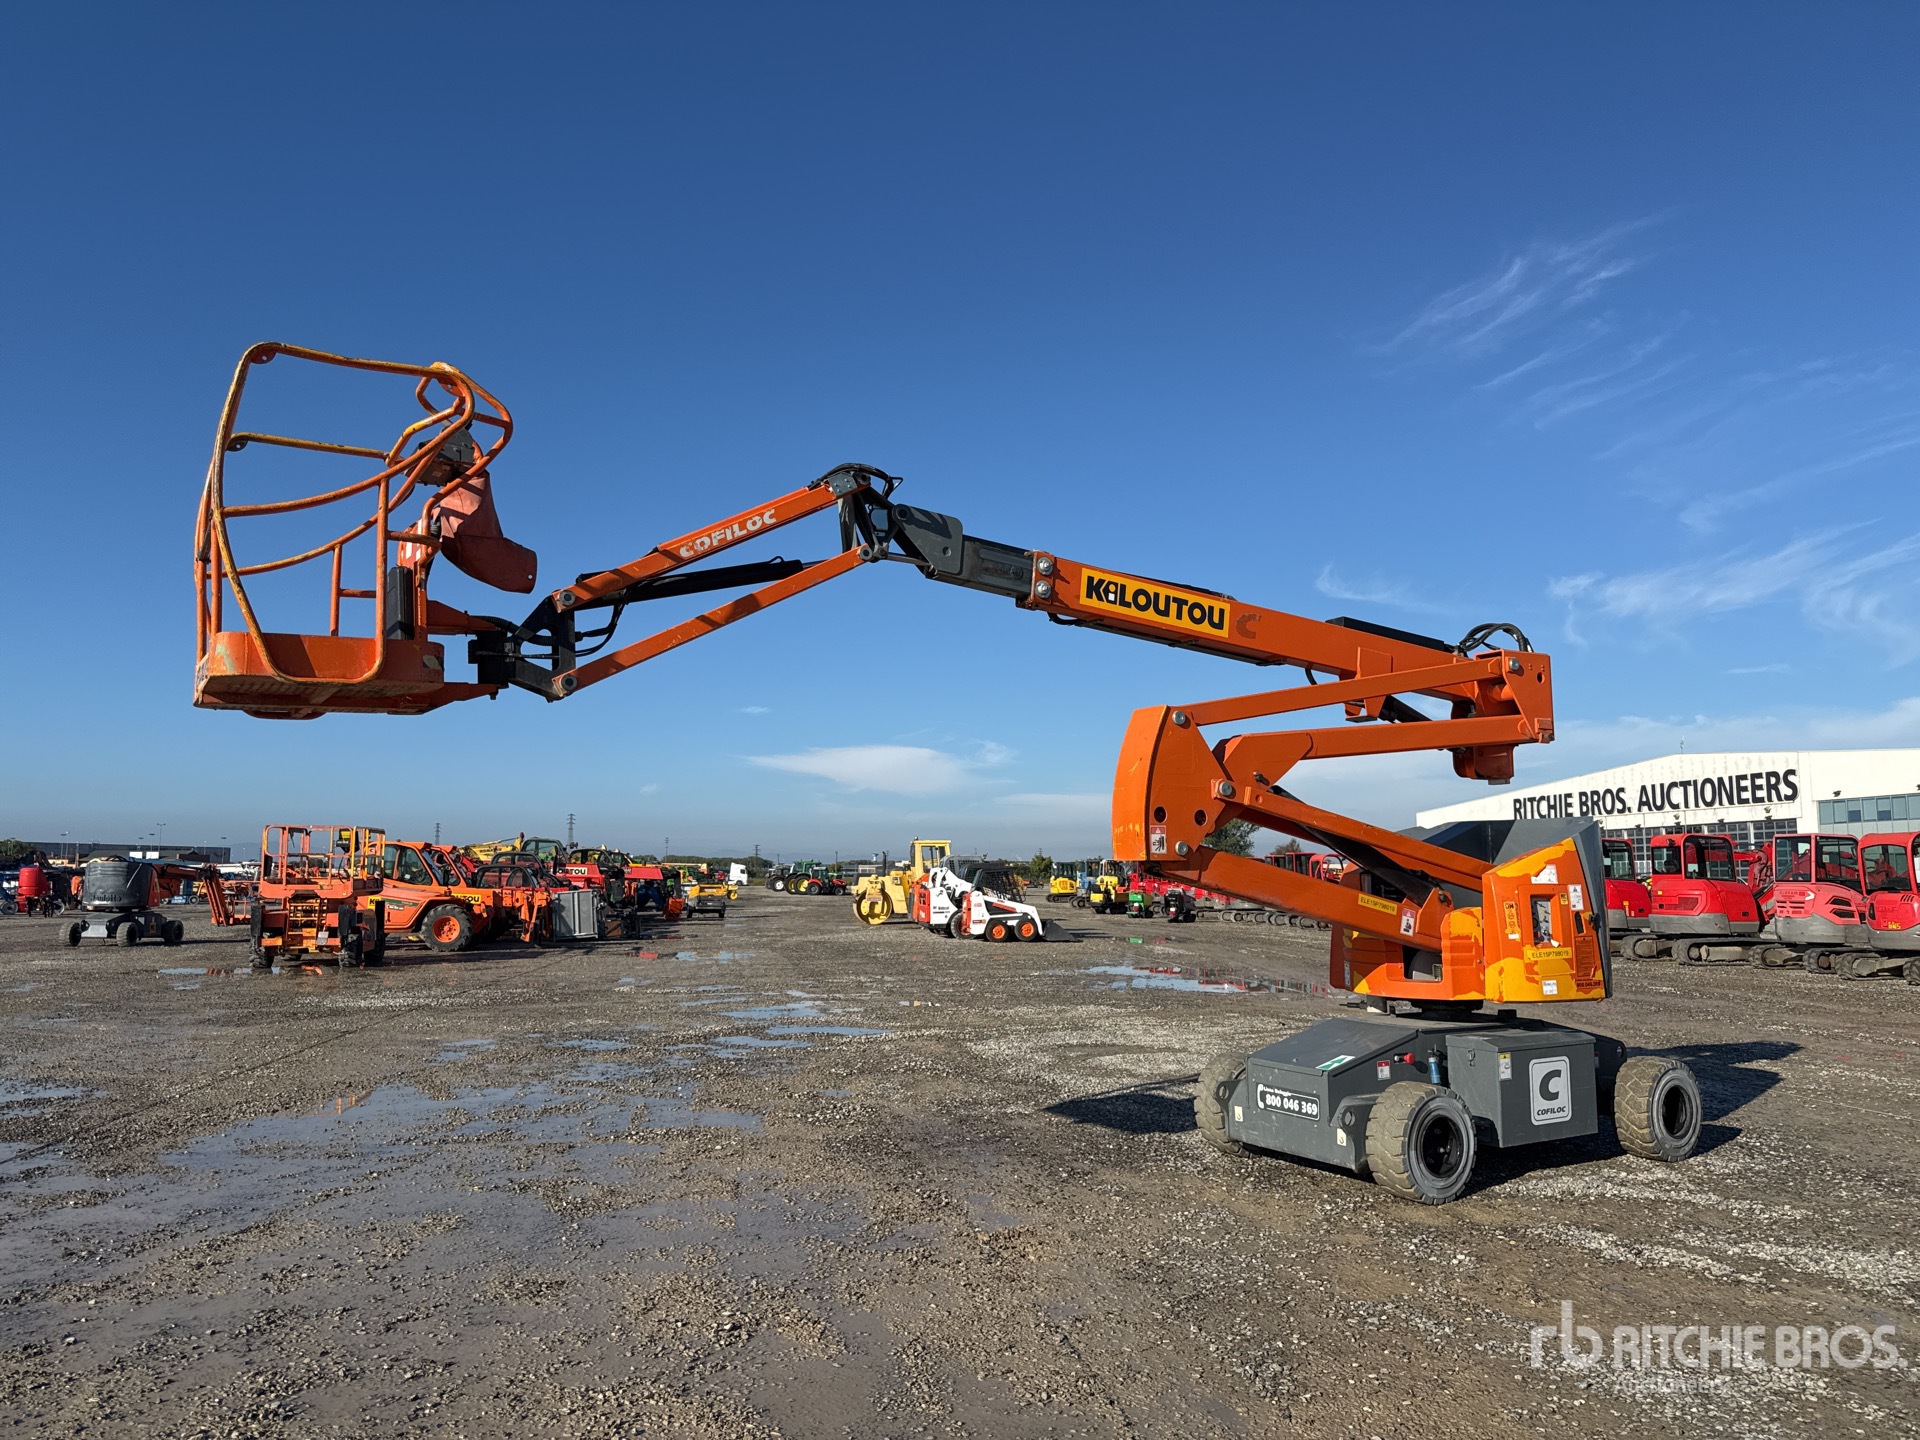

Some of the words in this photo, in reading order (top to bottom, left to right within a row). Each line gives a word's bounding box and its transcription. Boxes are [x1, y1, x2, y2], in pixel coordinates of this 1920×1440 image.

[680, 509, 776, 558] COFILOC
[1513, 792, 1573, 820] RITCHIE
[1579, 787, 1632, 816] BROS.
[1638, 769, 1798, 812] AUCTIONEERS
[1539, 1069, 1562, 1101] C
[1265, 1093, 1281, 1107] 800
[1283, 1097, 1299, 1112] 046
[1301, 1101, 1318, 1115] 369
[1537, 1106, 1567, 1116] COFILOC
